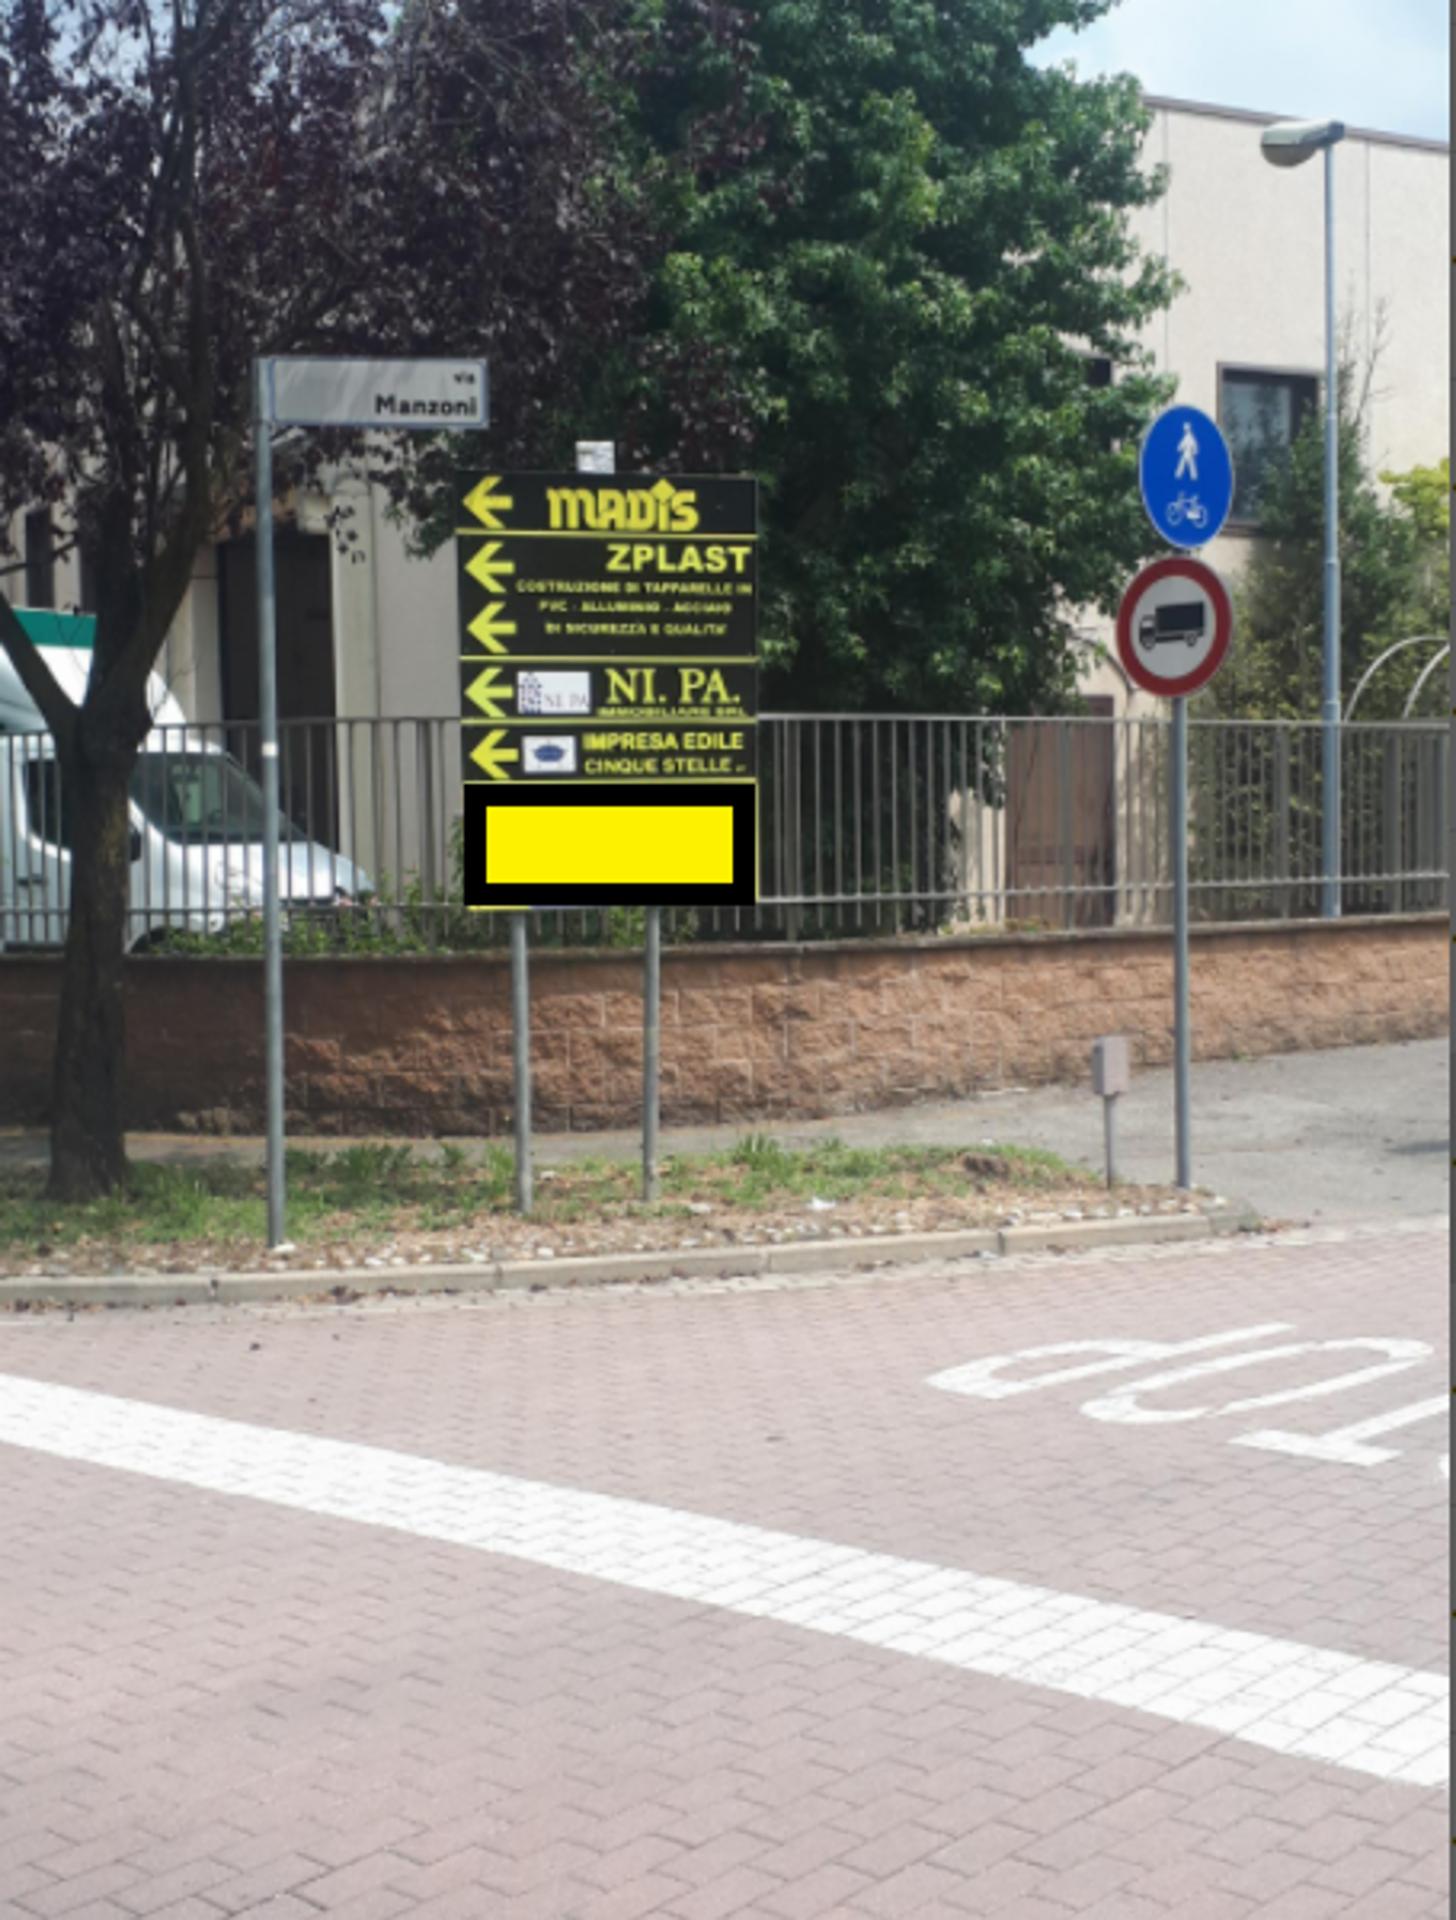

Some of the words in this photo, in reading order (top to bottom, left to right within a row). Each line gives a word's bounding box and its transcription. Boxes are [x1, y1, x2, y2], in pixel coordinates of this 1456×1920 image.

[453, 371, 475, 384] via
[375, 394, 477, 416] Manzoni
[606, 544, 751, 573] ZPLAST
[515, 579, 620, 593] COSTRUZIONE
[644, 581, 733, 596] TAPPARELLE
[605, 667, 667, 704] NI.
[678, 668, 741, 704] PA.
[581, 732, 679, 750] IMPRESA
[682, 732, 744, 750] EDILE
[584, 757, 658, 774] CINQUE
[662, 757, 732, 773] STELLE
[925, 1322, 1450, 1480] TOP
